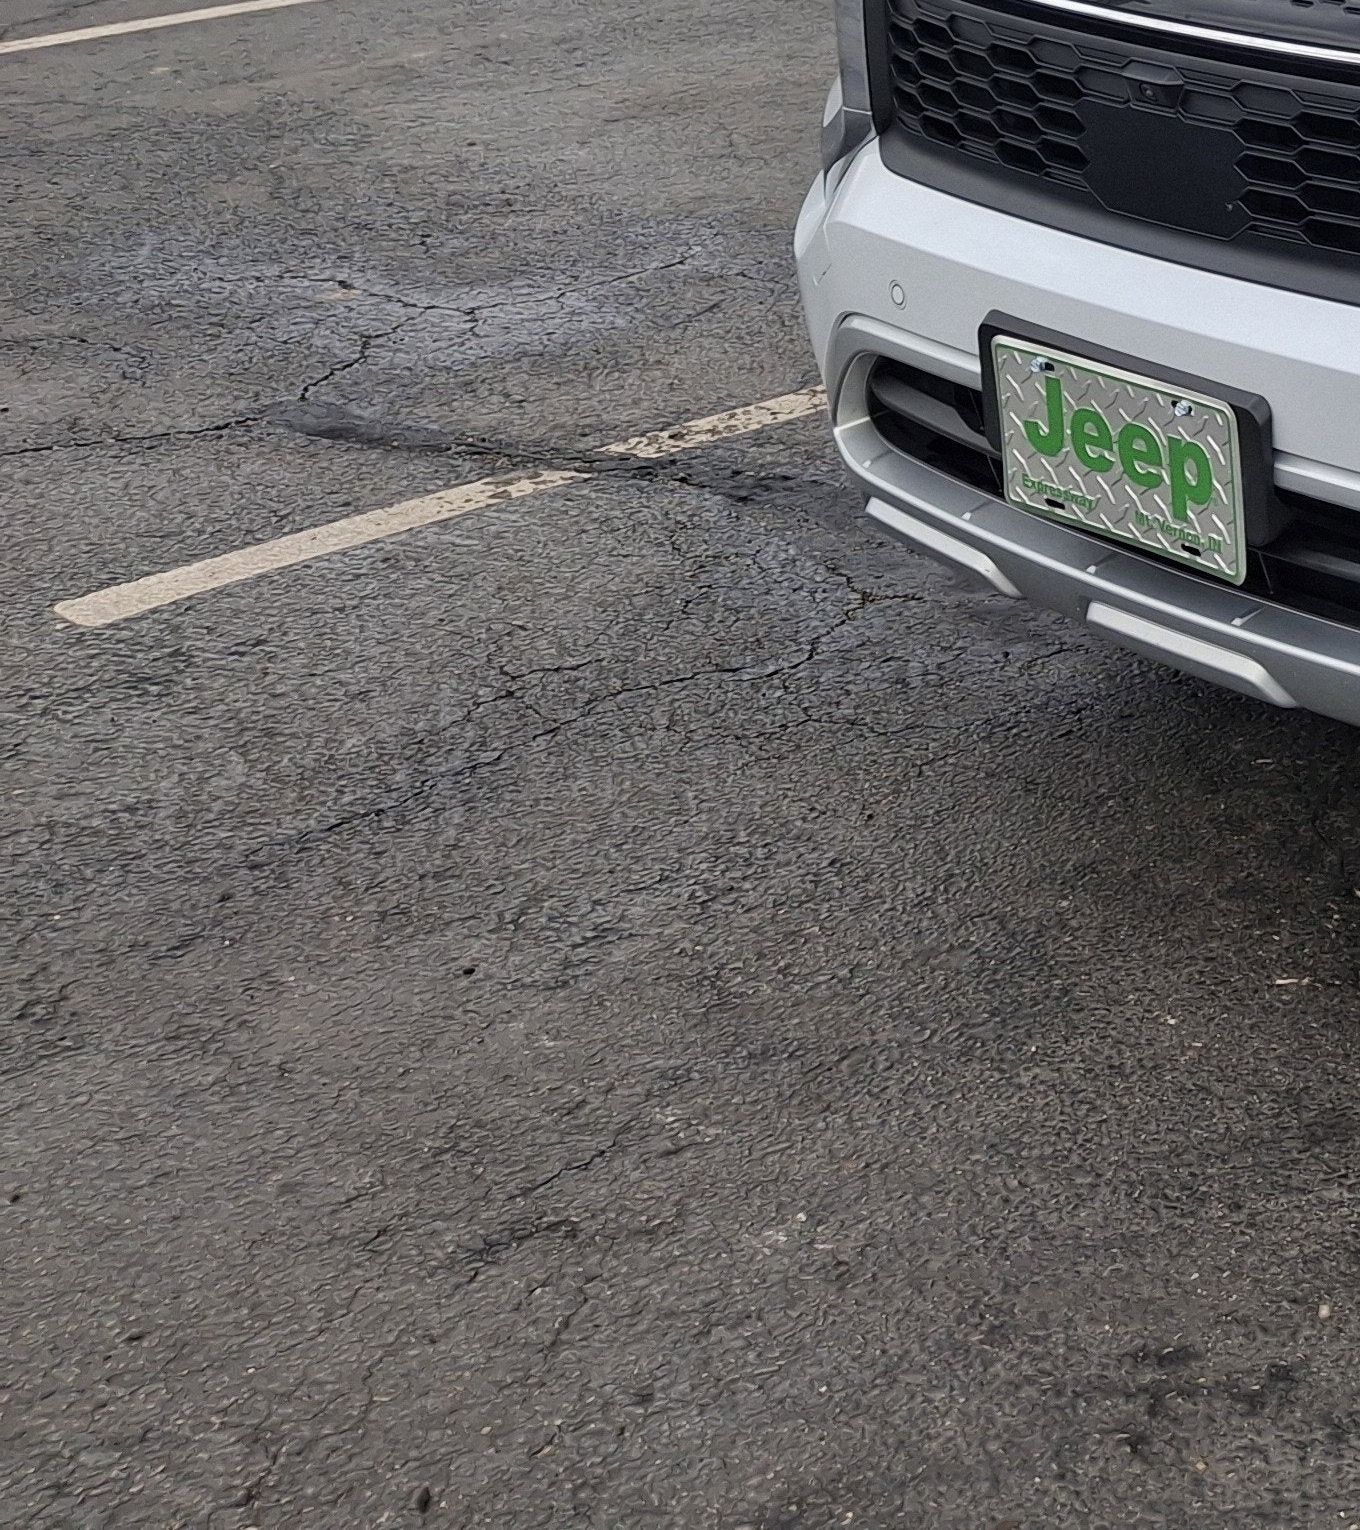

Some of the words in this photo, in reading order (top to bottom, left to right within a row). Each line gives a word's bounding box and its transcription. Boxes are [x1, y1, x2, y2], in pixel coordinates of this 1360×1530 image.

[1024, 375, 1213, 521] Jeep
[1022, 473, 1095, 514] Expressway
[1208, 535, 1223, 554] IN
